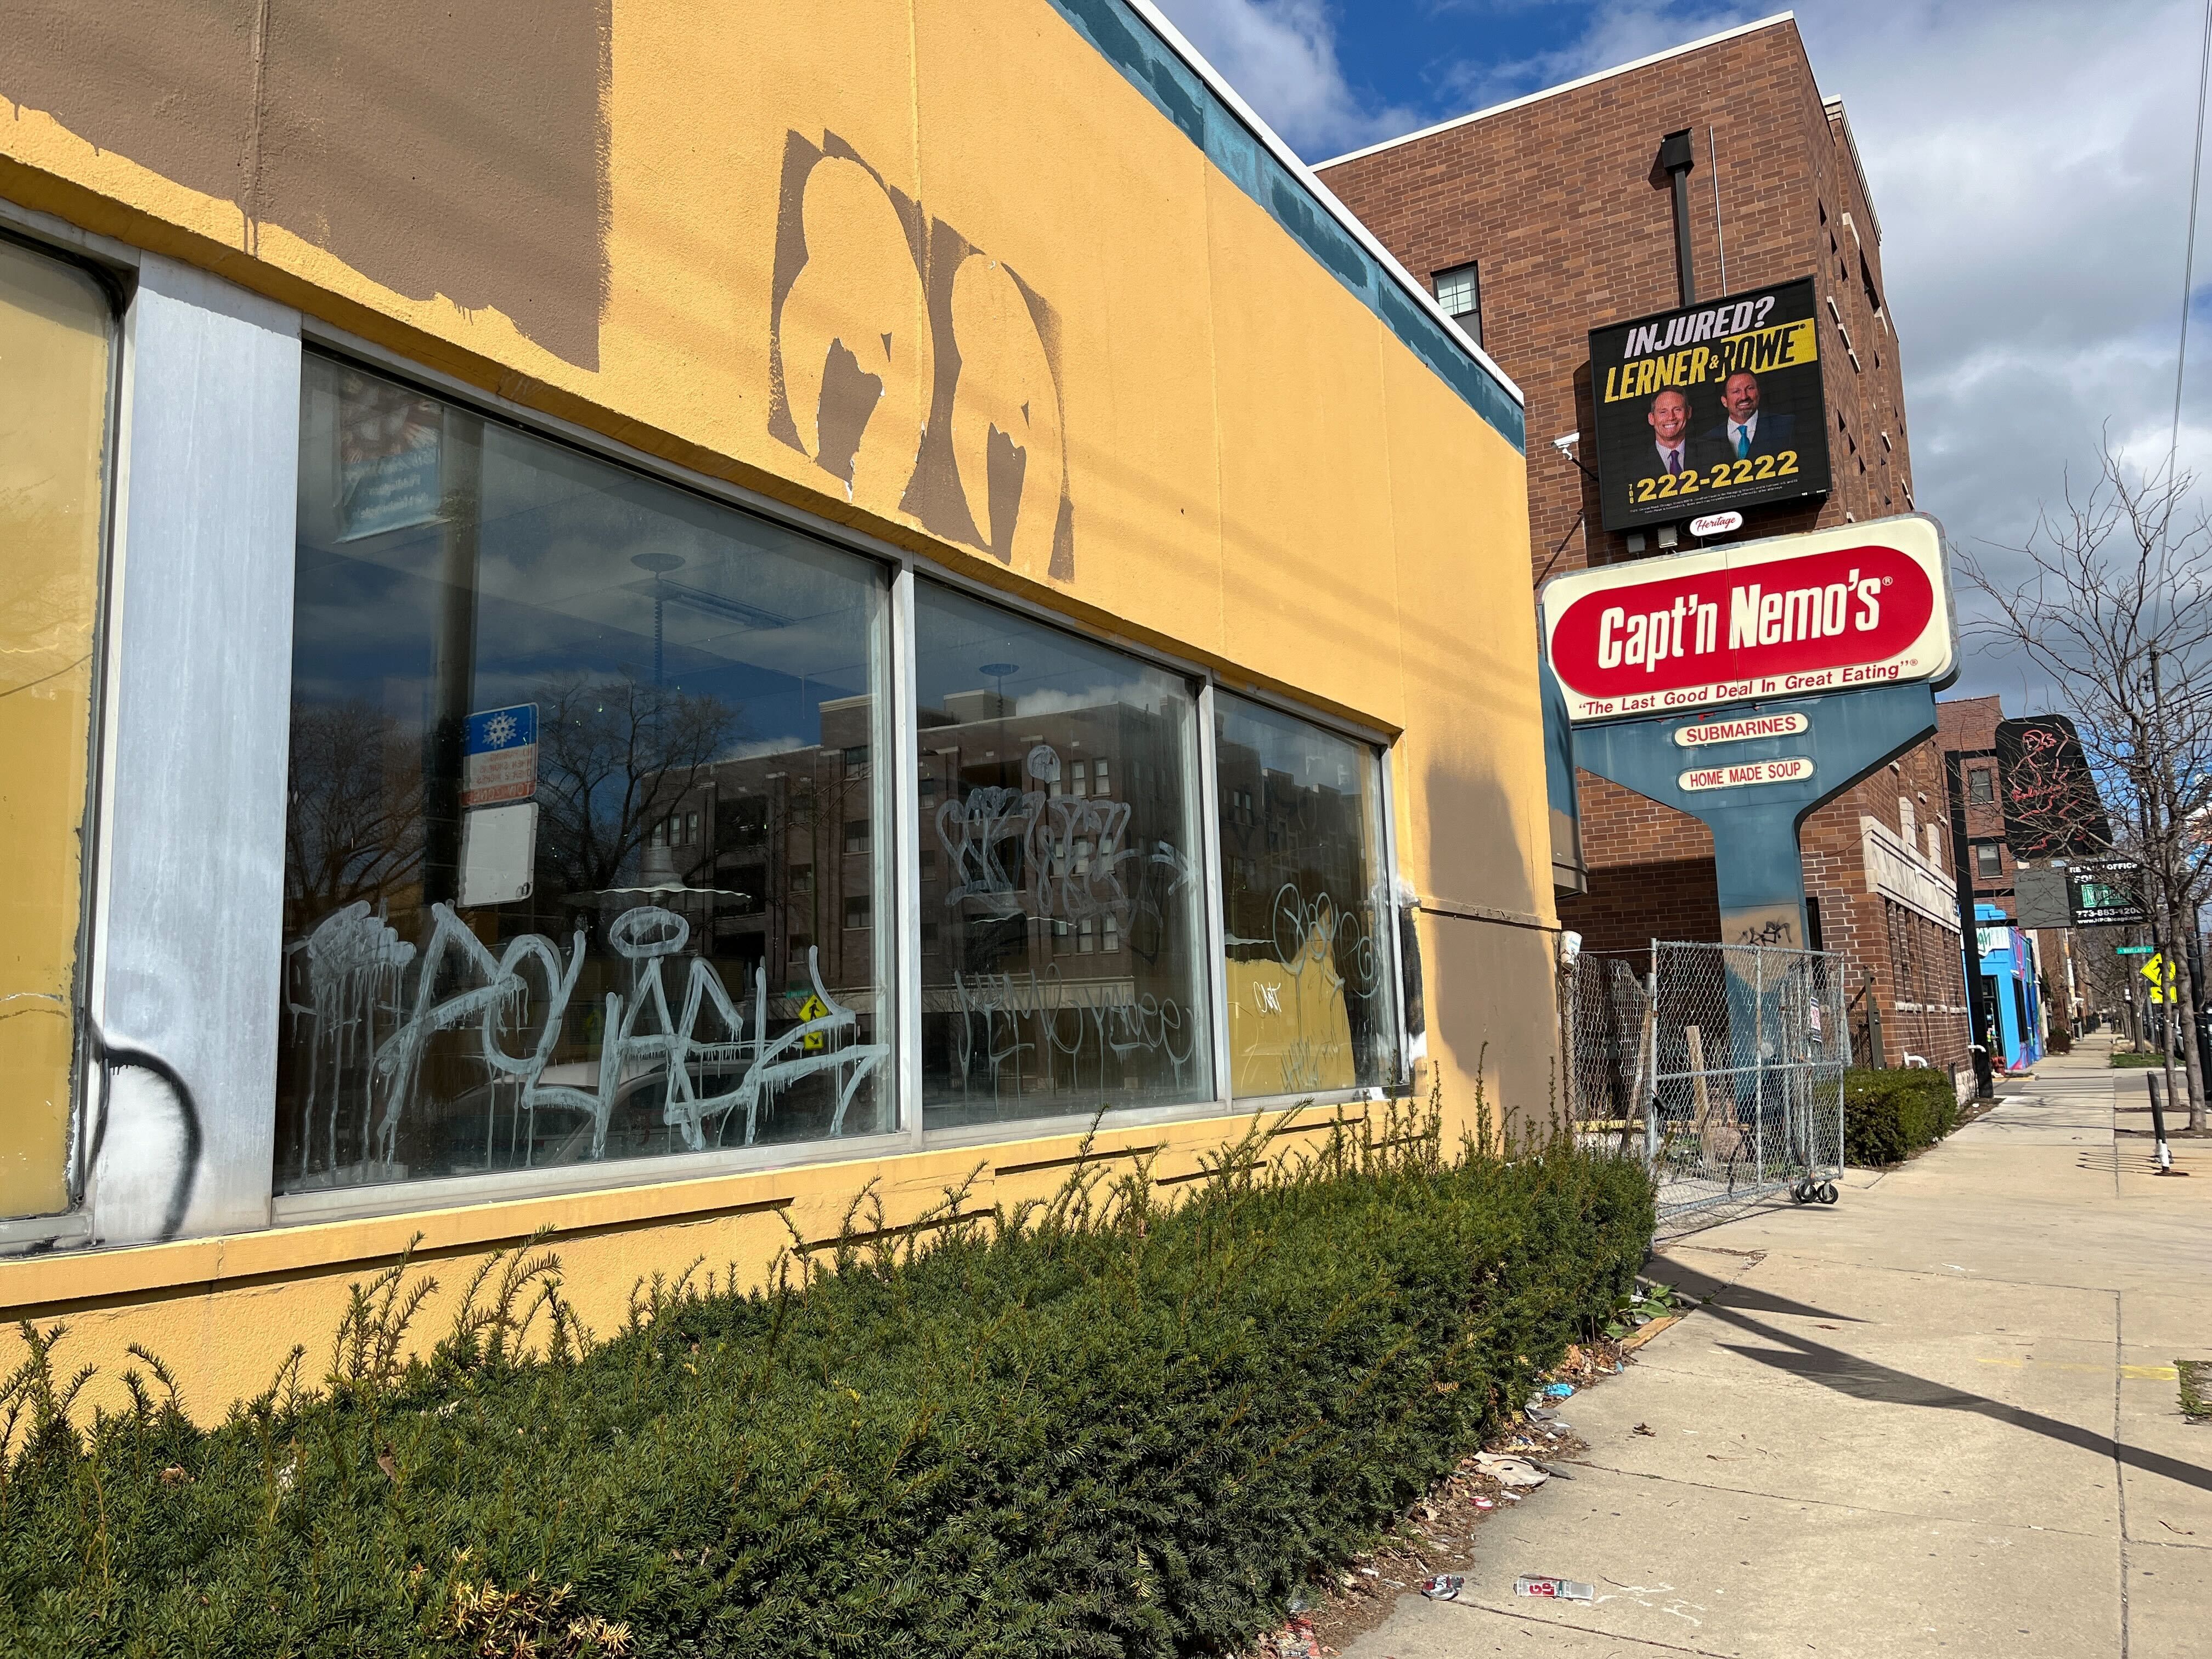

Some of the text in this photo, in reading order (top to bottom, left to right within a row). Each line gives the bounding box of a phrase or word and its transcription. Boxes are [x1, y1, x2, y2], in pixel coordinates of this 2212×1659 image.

[1623, 296, 1775, 359] INJURED?
[1604, 325, 1800, 403] LERNER & ROWE
[1637, 450, 1799, 503] 222-2222
[1695, 516, 1736, 531] Heritage
[1598, 594, 1718, 673] Capt'n
[1622, 695, 1655, 711] Last
[1664, 687, 1708, 706] Good
[1716, 681, 1753, 699] Deal
[1762, 679, 1775, 693] In
[1785, 672, 1832, 690] Great
[1686, 716, 1797, 742] SUBMARINES
[1690, 762, 1801, 787] HOME MADE SOUP
